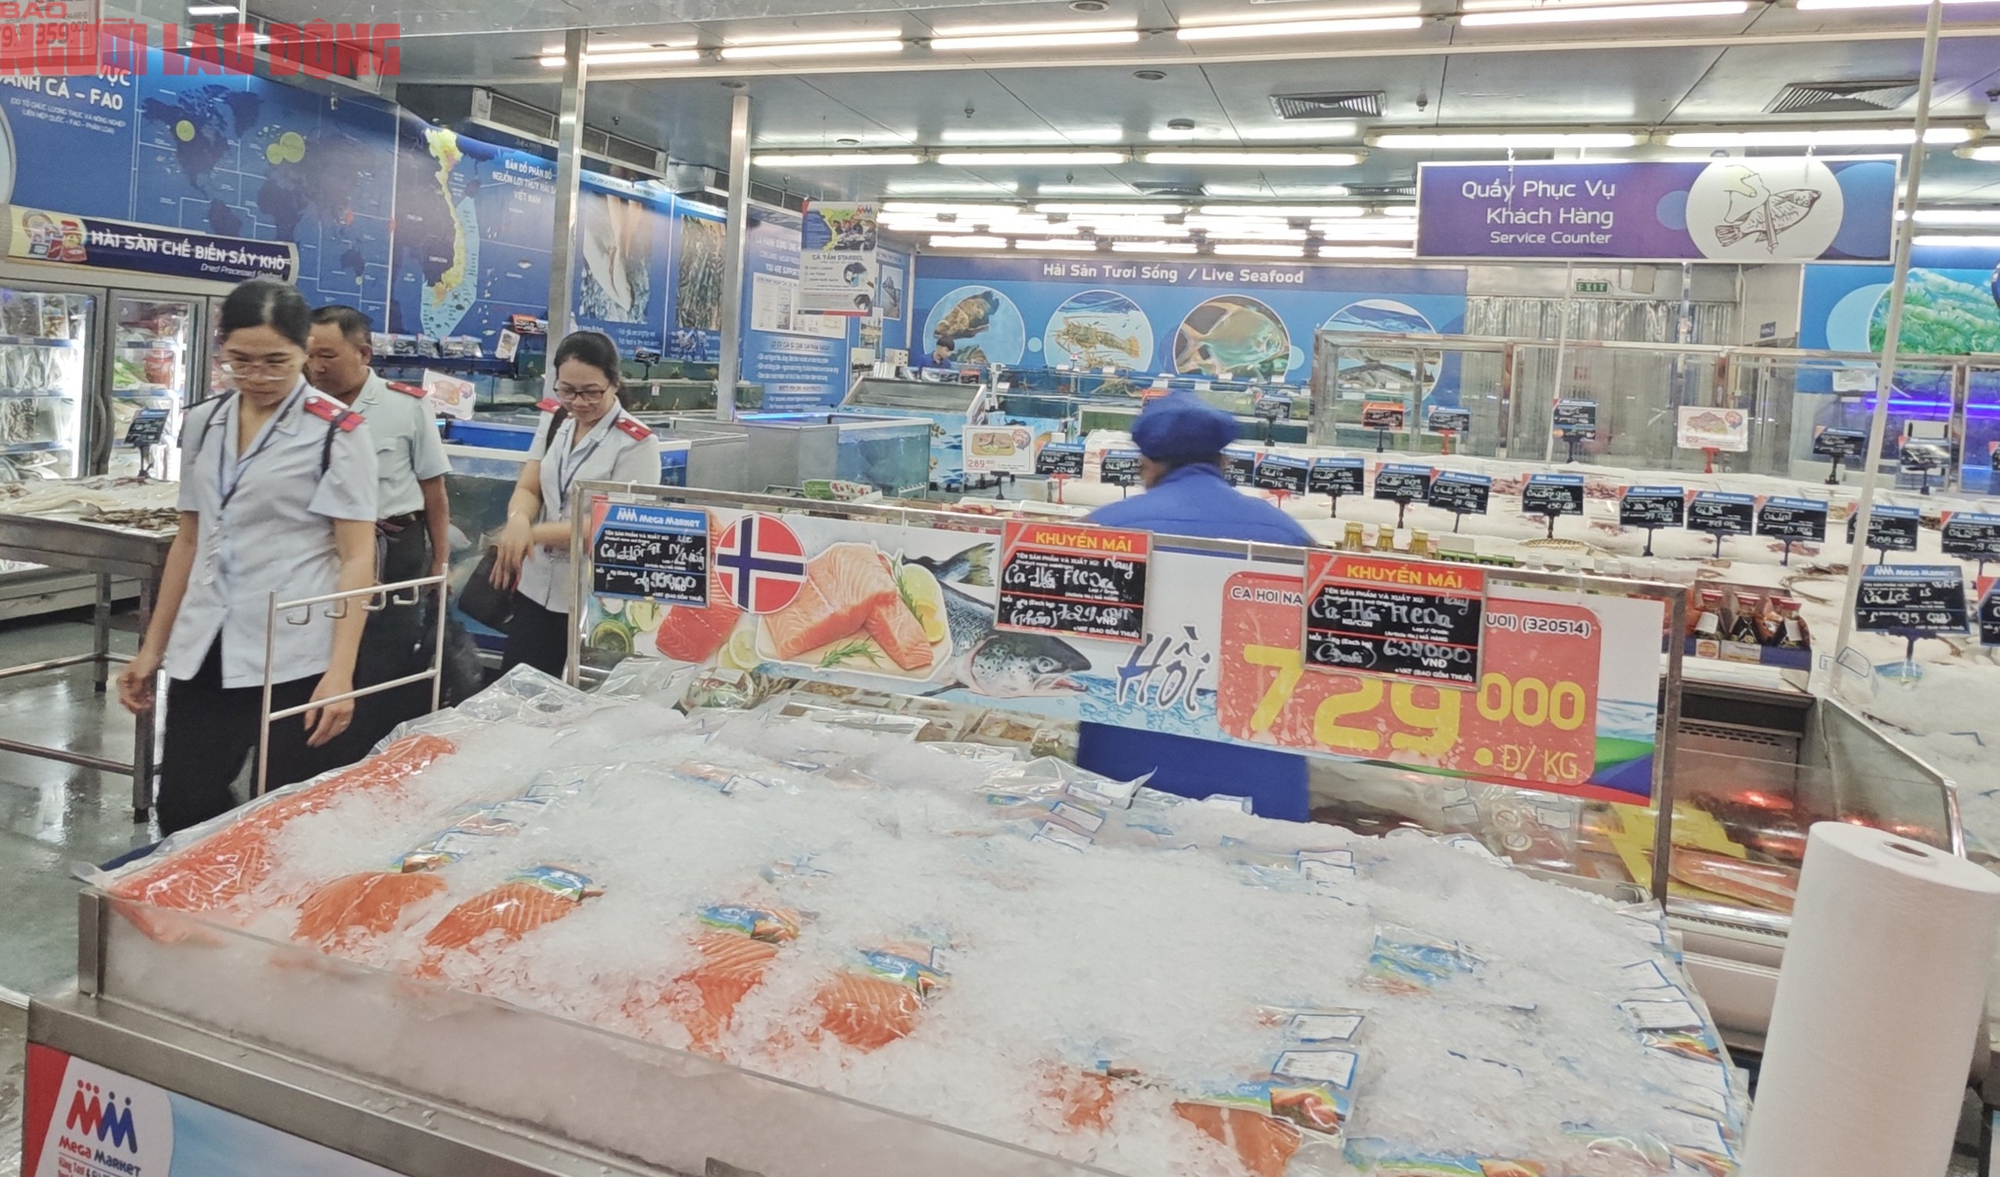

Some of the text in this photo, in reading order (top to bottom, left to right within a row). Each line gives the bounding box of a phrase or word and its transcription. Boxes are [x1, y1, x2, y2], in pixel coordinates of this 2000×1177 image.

[90, 88, 123, 110] FAO
[1462, 179, 1616, 202] Quầy Phục Vụ
[1487, 207, 1614, 228] Khách Hàng
[1490, 231, 1612, 245] Service Counter
[1044, 263, 1065, 276] Hải
[1070, 264, 1097, 278] Sản
[1103, 266, 1136, 278] Tươi
[1141, 264, 1178, 283] Sống
[1202, 268, 1234, 282] Live
[1239, 269, 1304, 284] Seafood
[1577, 282, 1606, 292] EXIT
[968, 459, 985, 468] 289
[1036, 530, 1132, 552] KHUYẾN MÃI
[1347, 563, 1463, 590] KHUYẾN MÃI
[1256, 590, 1278, 603] HOI
[1522, 617, 1590, 637] (320514)
[1117, 626, 1211, 711] Hồi
[1421, 657, 1448, 669] VNĐ
[1476, 672, 1585, 731] 000
[1544, 751, 1578, 780] KG
